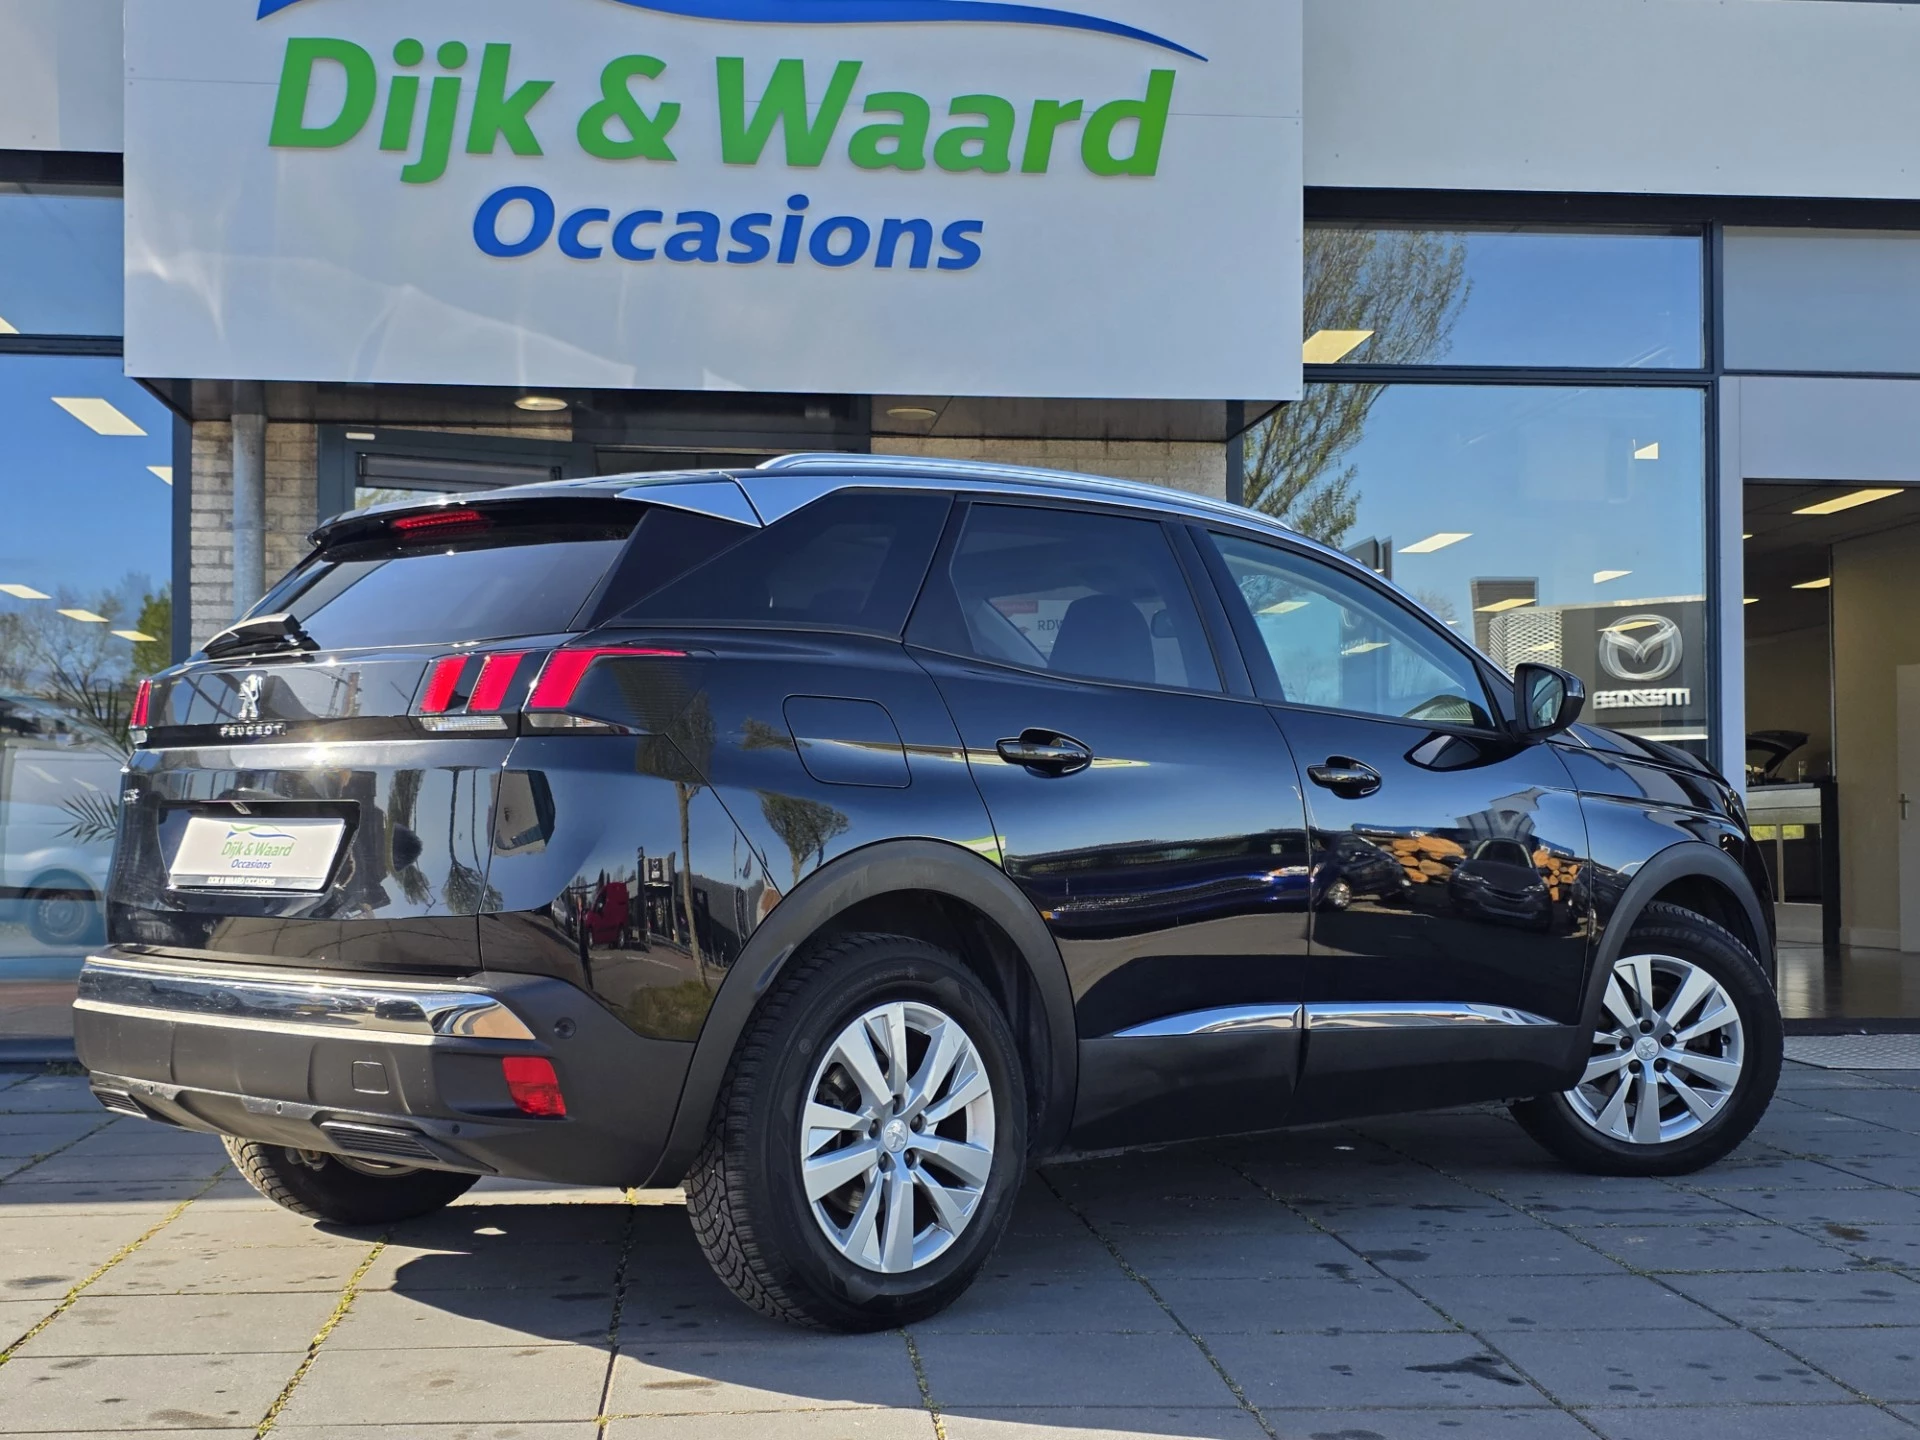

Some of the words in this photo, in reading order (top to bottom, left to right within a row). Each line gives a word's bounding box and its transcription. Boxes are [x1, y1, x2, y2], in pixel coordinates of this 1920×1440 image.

[268, 37, 555, 184] Dijk
[576, 54, 681, 162] &
[716, 57, 1177, 177] Waard
[473, 185, 985, 271] Occasions
[220, 724, 283, 737] PEUGEOT
[221, 841, 243, 859] Dijk
[243, 842, 253, 856] &
[254, 841, 295, 857] Waard
[231, 859, 272, 869] Occasions
[1629, 926, 1703, 944] ICHELIN
